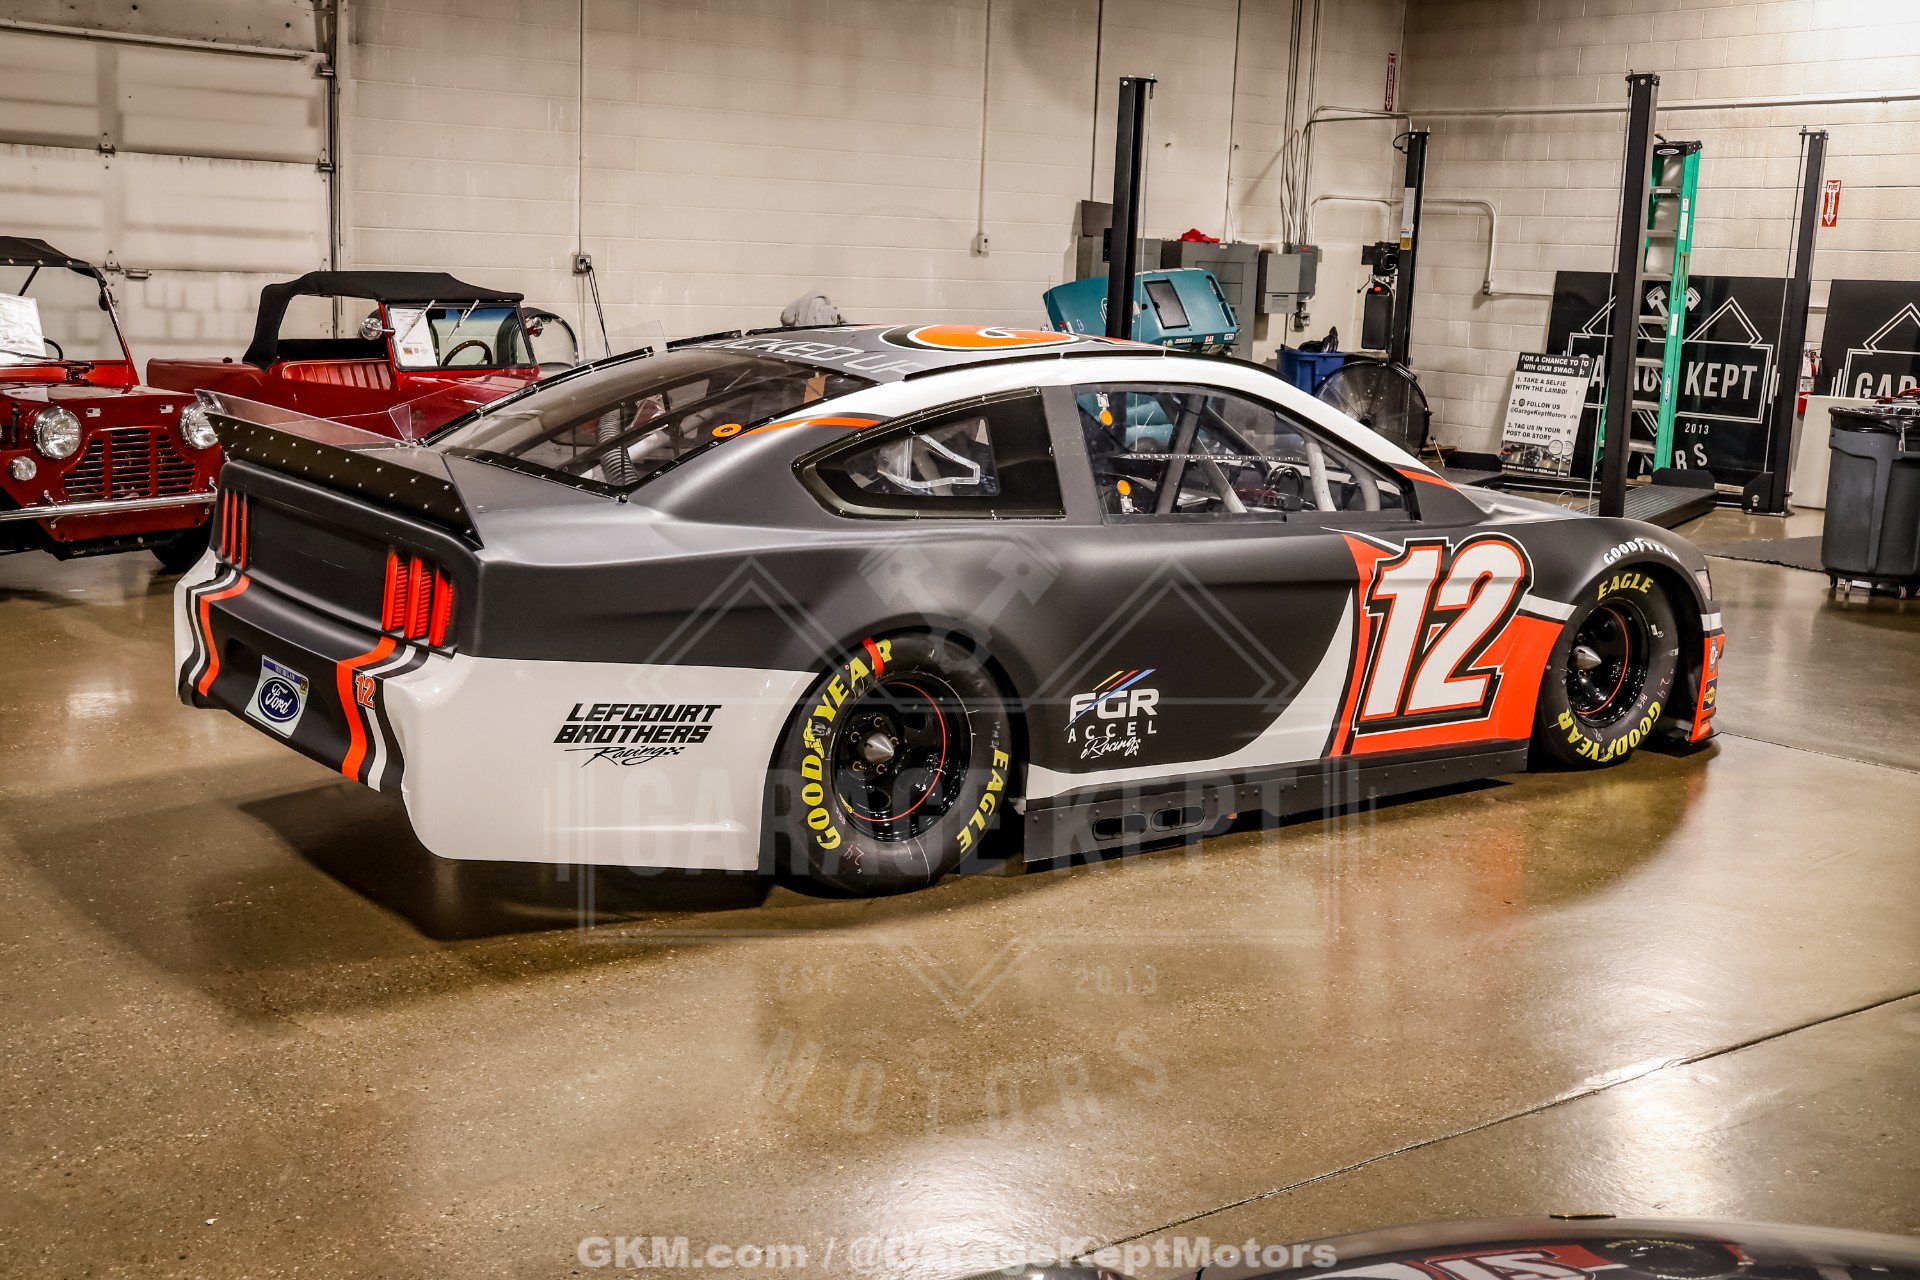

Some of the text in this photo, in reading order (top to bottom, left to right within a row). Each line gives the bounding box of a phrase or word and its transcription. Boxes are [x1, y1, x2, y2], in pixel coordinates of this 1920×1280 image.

[1541, 357, 1568, 365] CHANCE
[1546, 379, 1567, 387] SELFIE
[1684, 361, 1758, 400] KEPT
[1684, 422, 1710, 435] 2013
[1603, 537, 1680, 565] GOODYEAR
[1597, 573, 1654, 601] EAGLE
[1355, 535, 1531, 732] 12
[265, 683, 294, 715] Ford
[355, 674, 376, 710] 12
[1069, 688, 1160, 723] FGR
[565, 702, 723, 723] LEFCOURT
[552, 724, 714, 744] BROTHERS
[801, 639, 892, 850] GOODYEAR
[1067, 719, 1158, 744] ACCEL
[1557, 701, 1661, 763] GOODYEAR
[563, 744, 668, 769] Racing
[955, 749, 1010, 854] EAGLE
